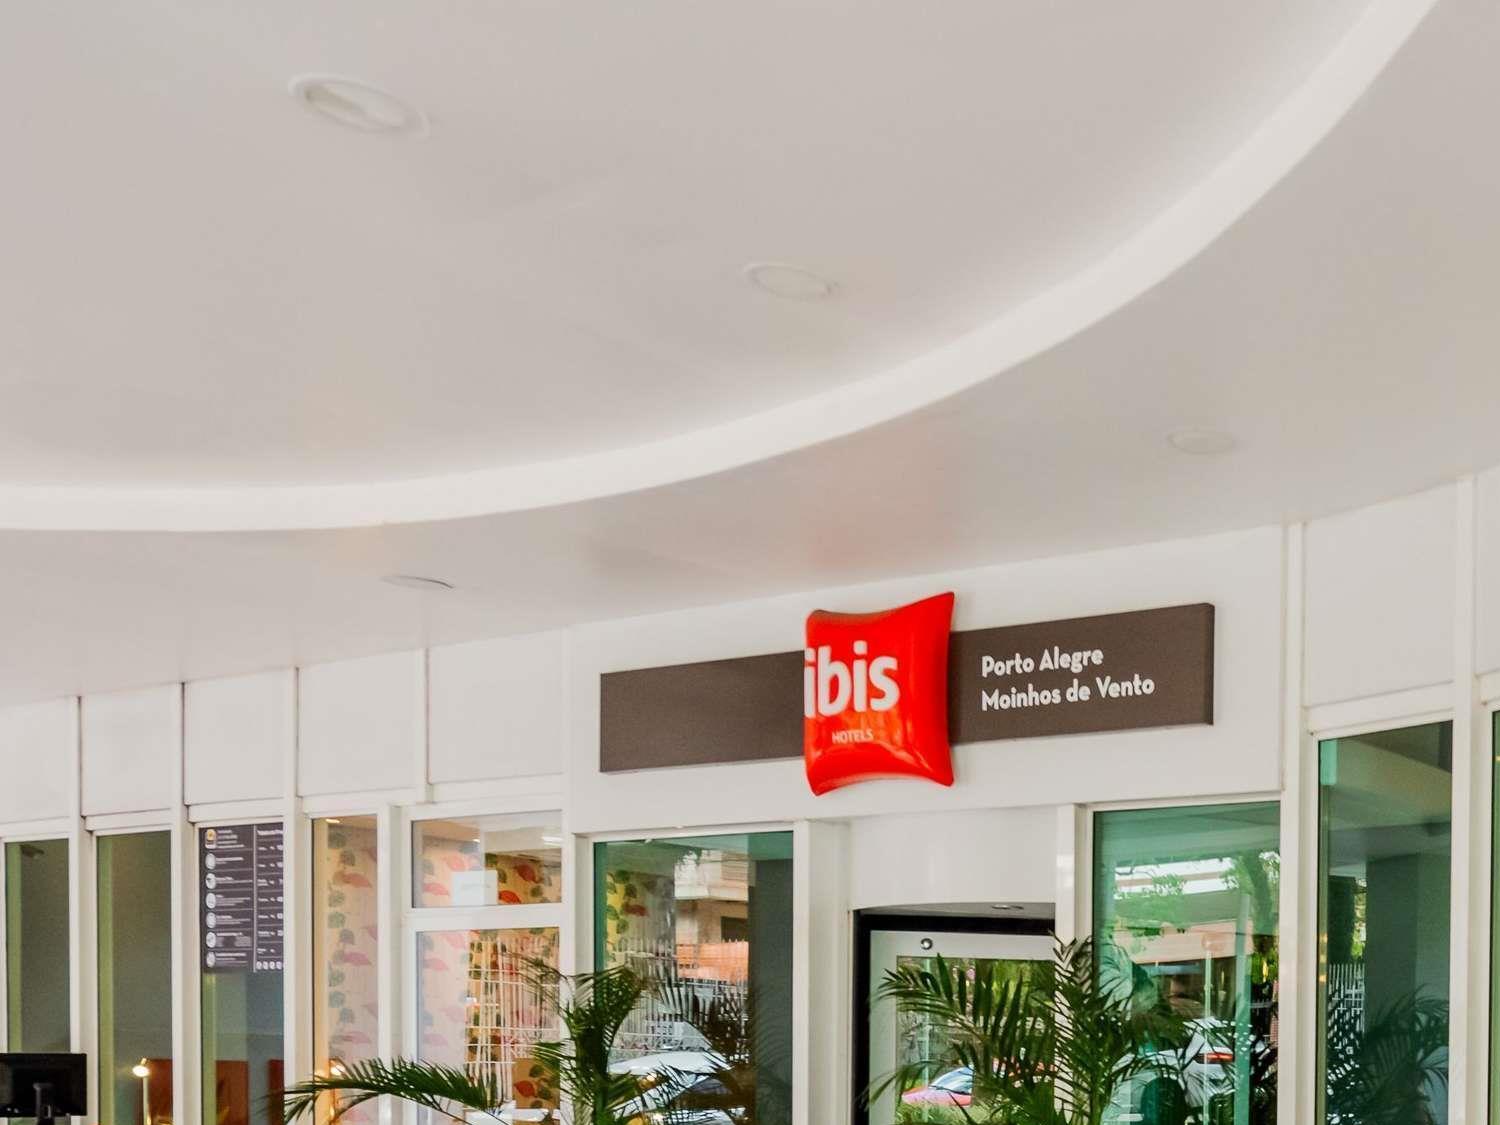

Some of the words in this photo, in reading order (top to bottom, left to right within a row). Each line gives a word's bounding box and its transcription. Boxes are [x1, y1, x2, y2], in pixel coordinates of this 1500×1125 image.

[981, 653, 1035, 677] Porto
[1039, 646, 1104, 673] Alegre
[804, 640, 901, 718] ibis
[981, 683, 1061, 711] Moinhos
[1066, 678, 1091, 702] de
[1096, 673, 1155, 698] Vento
[831, 728, 874, 744] HOTELS
